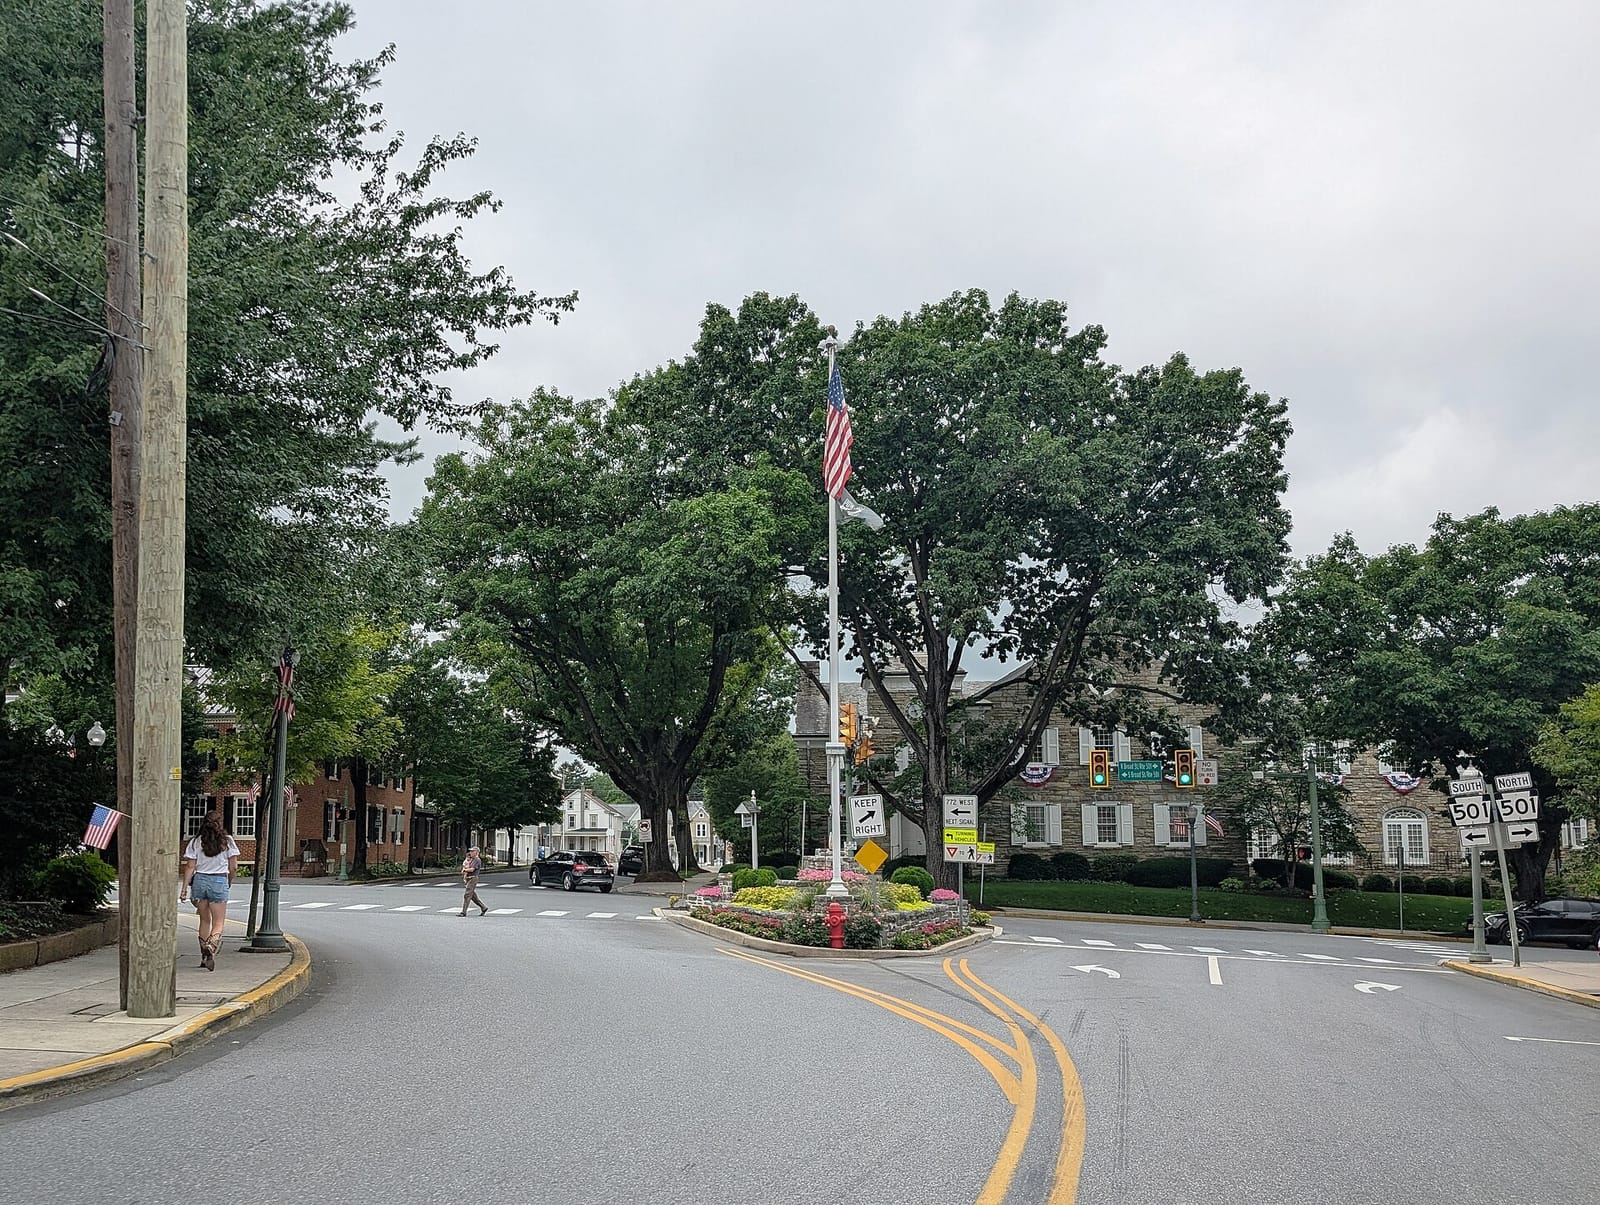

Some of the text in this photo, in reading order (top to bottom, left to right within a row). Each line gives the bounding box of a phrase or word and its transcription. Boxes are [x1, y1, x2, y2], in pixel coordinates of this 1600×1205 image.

[1452, 782, 1482, 793] SOUTH
[1498, 776, 1528, 788] NORTH
[854, 799, 876, 808] KEEP
[1501, 798, 1536, 816] 501
[1453, 802, 1488, 820] 501
[856, 825, 881, 834] RIGHT
